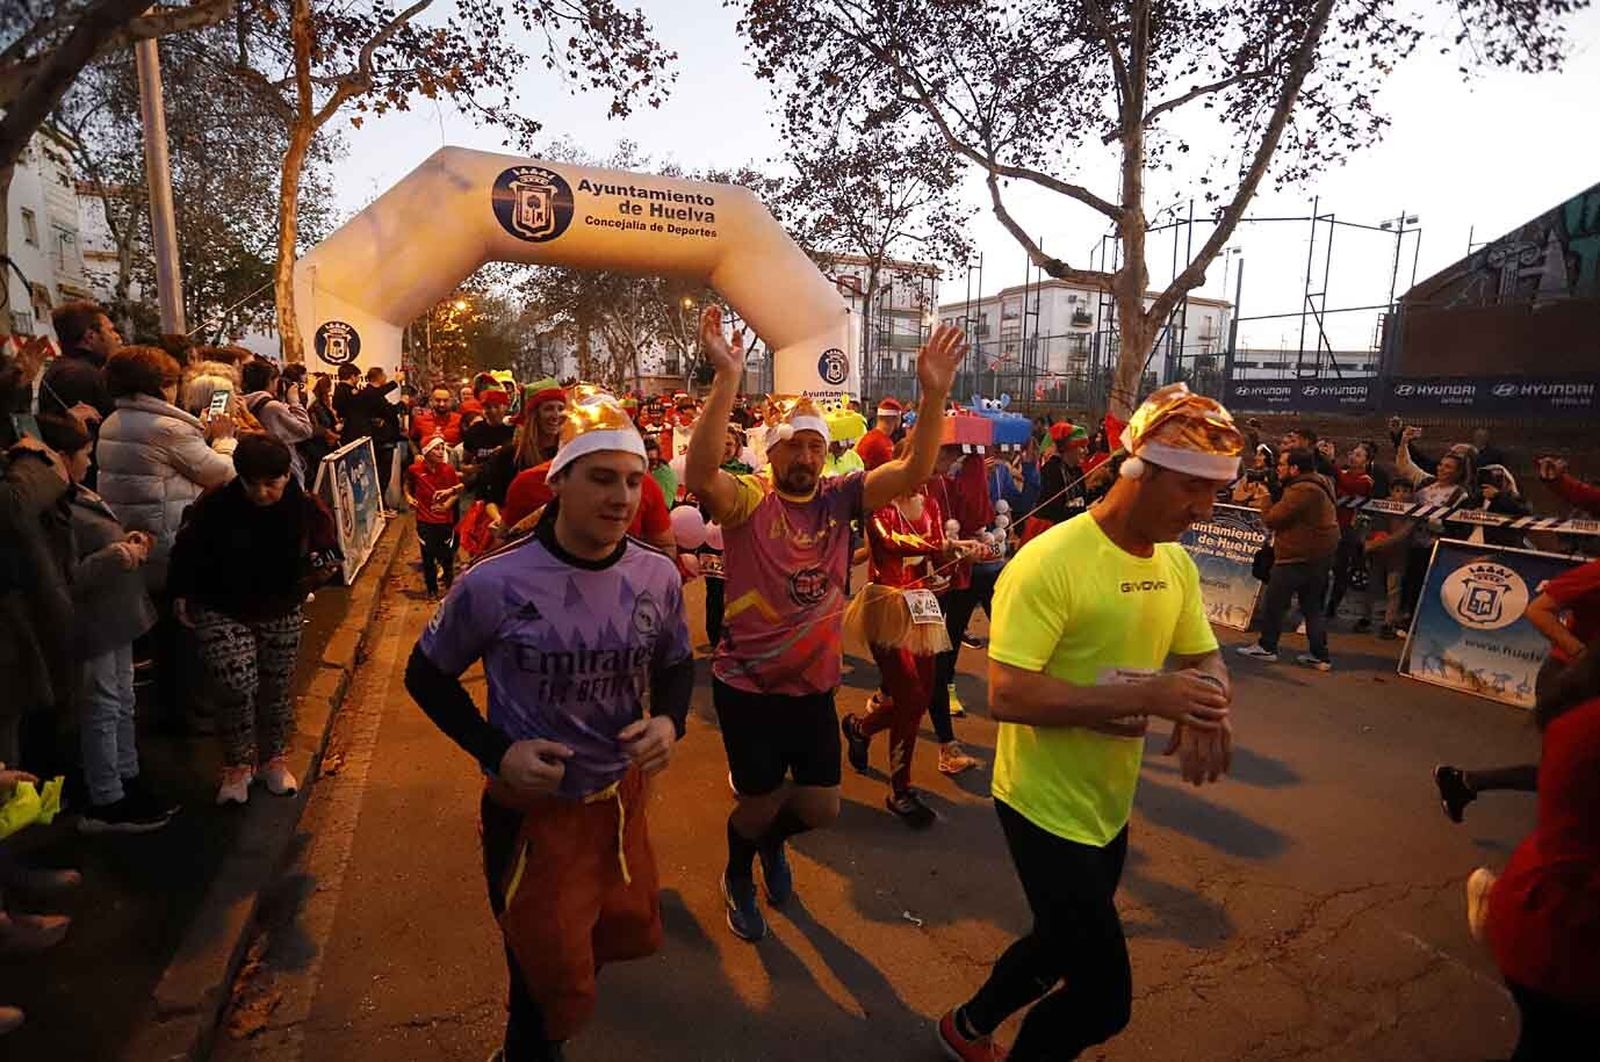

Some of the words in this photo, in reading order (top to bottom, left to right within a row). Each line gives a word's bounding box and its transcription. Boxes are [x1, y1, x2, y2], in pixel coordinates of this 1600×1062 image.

[578, 178, 714, 206] Ayuntamiento
[618, 201, 643, 215] de
[649, 202, 715, 224] Huelva
[650, 222, 664, 233] de
[667, 224, 717, 238] Deportes
[1251, 386, 1291, 395] HYUNDAI
[1320, 386, 1368, 395] HYUNDAI
[1416, 385, 1476, 396] HYUNDAI
[1520, 384, 1595, 396] HYUNDAI
[1198, 534, 1214, 545] de
[517, 644, 655, 674] Emirate
